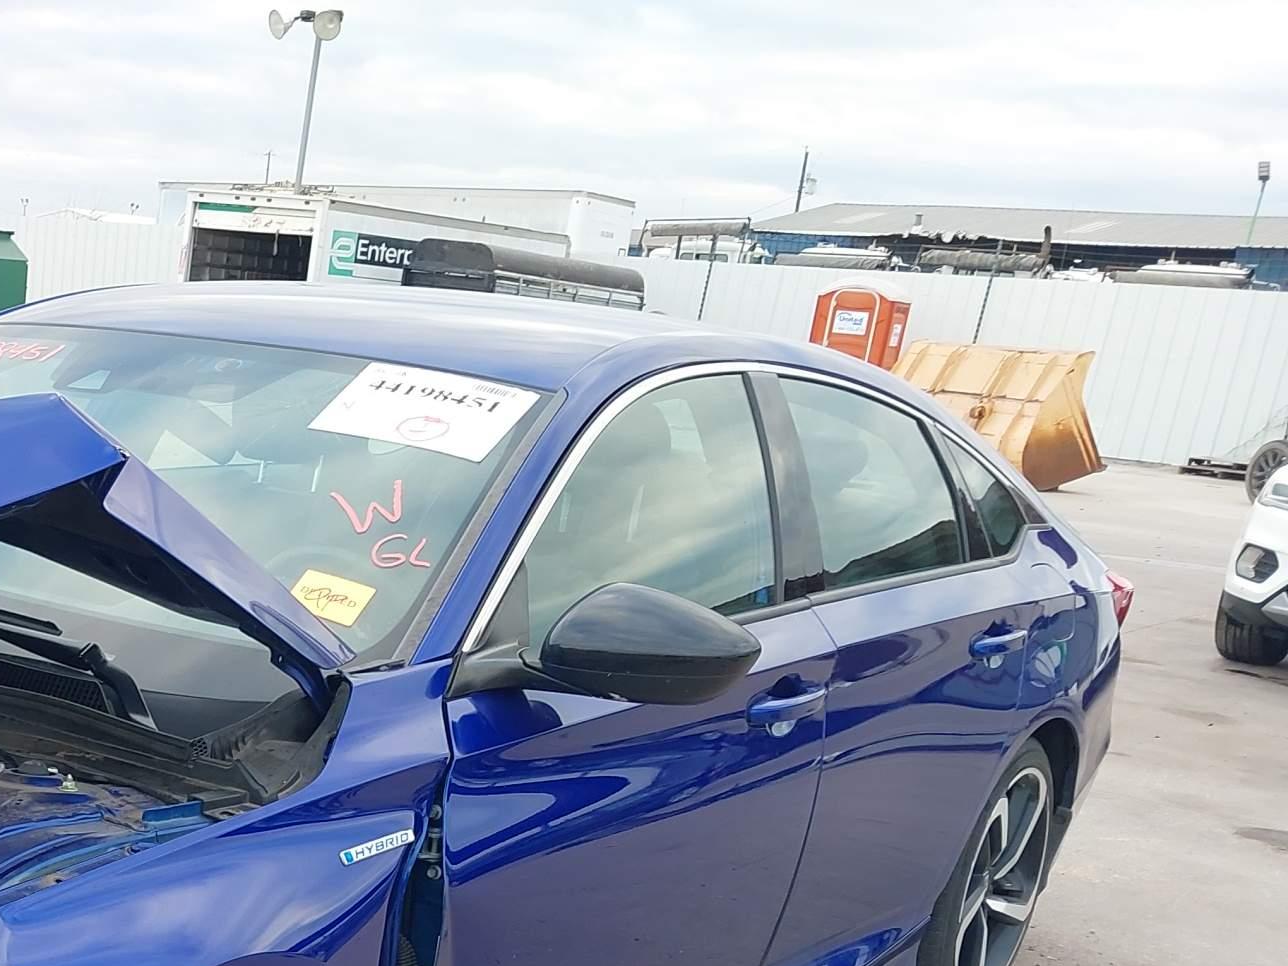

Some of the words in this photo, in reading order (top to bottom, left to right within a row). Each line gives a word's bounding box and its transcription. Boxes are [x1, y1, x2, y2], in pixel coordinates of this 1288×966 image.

[369, 379, 501, 413] 44198451
[329, 479, 403, 534] W
[354, 832, 410, 860] HYBRID
